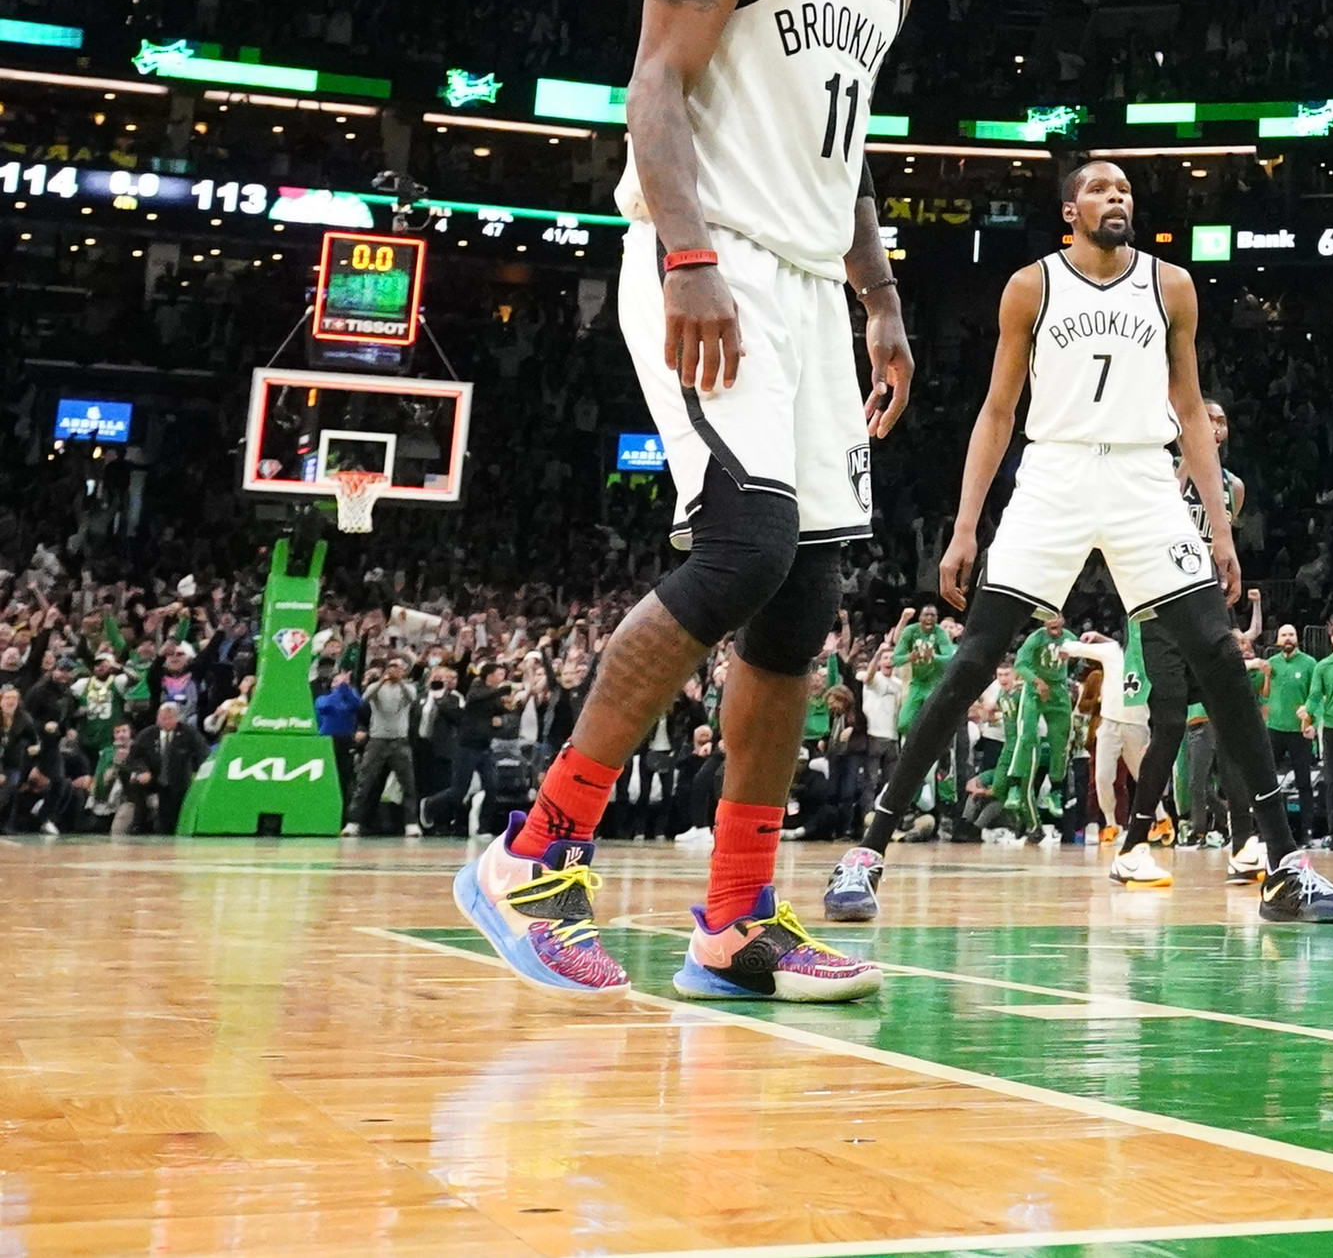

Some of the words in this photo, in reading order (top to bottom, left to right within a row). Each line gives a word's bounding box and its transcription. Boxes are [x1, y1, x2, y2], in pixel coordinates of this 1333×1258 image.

[774, 2, 887, 73] BROOKLY
[821, 72, 859, 163] 11
[0, 161, 79, 199] 114
[191, 179, 268, 215] 113
[482, 222, 505, 238] 47
[1236, 228, 1296, 249] Bank
[351, 244, 394, 271] 0.0
[345, 320, 409, 336] TISSOT
[1048, 309, 1158, 350] BROOKLYN
[1093, 354, 1112, 403] 7
[251, 715, 287, 731] Google
[289, 716, 314, 730] Pixel
